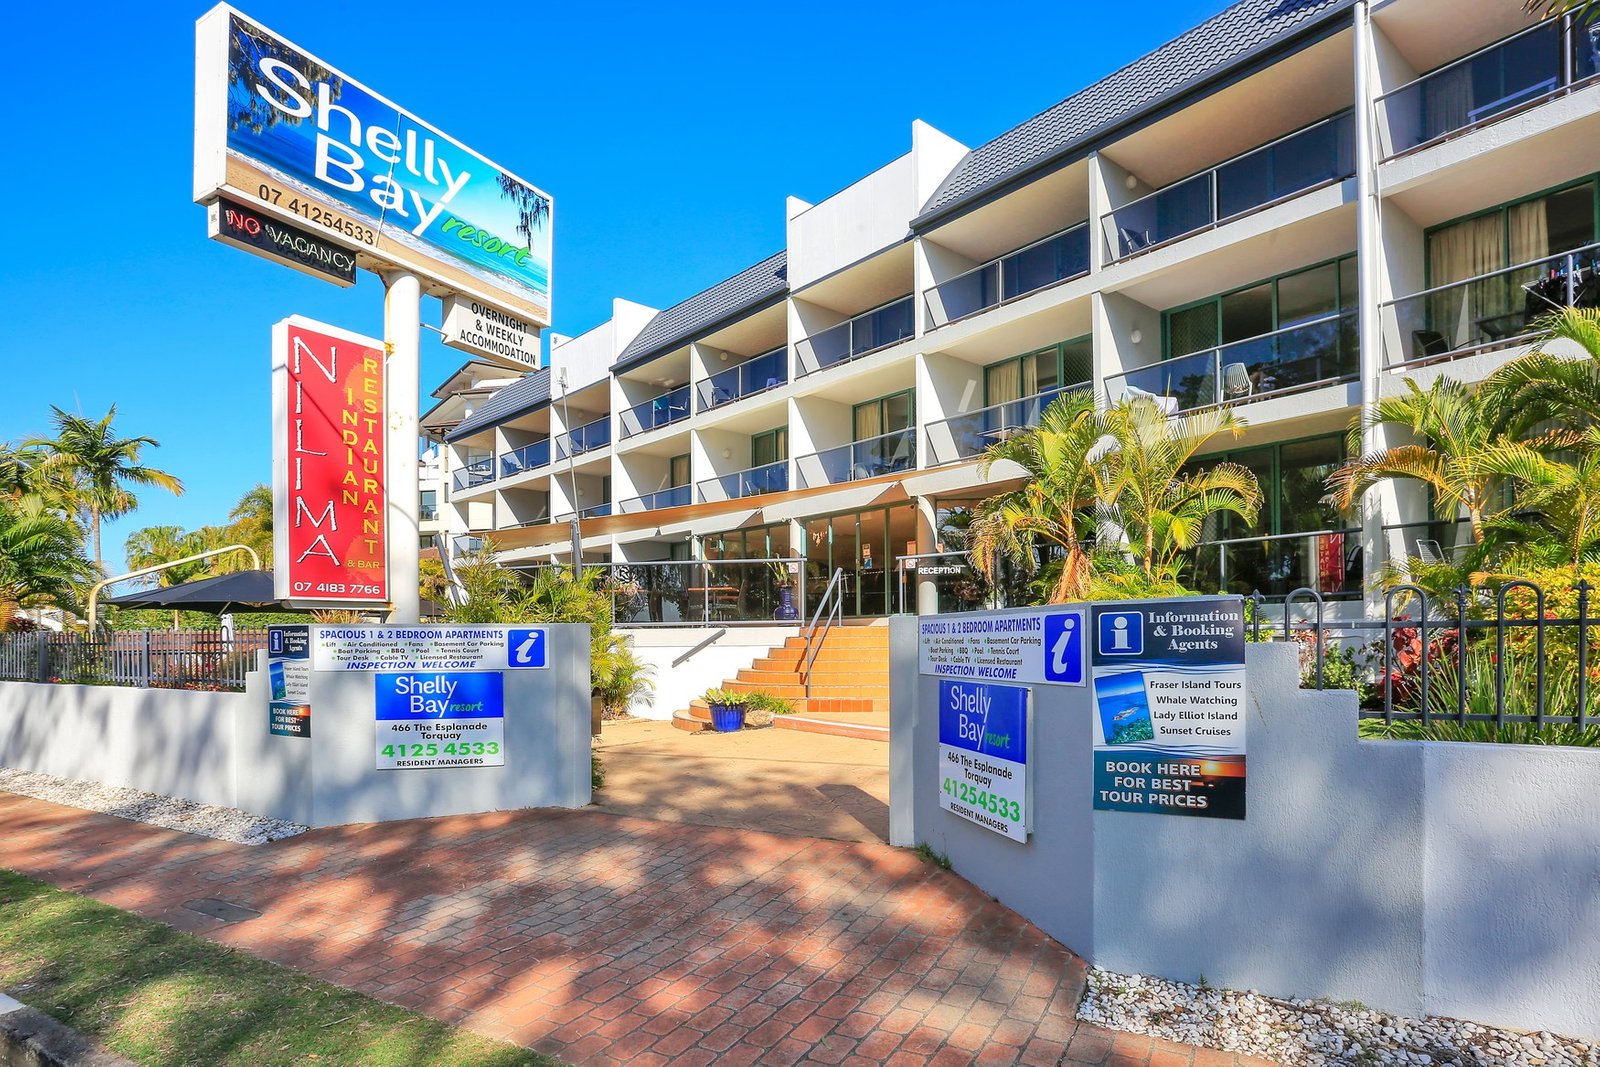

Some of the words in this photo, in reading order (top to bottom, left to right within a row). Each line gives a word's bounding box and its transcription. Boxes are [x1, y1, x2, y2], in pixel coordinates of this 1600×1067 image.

[255, 57, 471, 203] Shelly
[314, 132, 446, 237] Bay
[441, 216, 533, 267] resort
[258, 184, 282, 206] 07
[288, 198, 374, 246] 41254533
[227, 210, 260, 234] NO
[270, 226, 355, 272] VACANCY
[471, 302, 528, 334] OVERNIGHT
[475, 319, 483, 332] &
[486, 323, 524, 346] WEEKLY
[460, 329, 536, 365] ACCOMMODATION
[292, 335, 341, 567] NILIMA
[342, 387, 359, 506] INDIAN
[362, 357, 380, 556] RESTAURANT
[347, 559, 355, 568] &
[357, 560, 380, 569] BAR
[918, 566, 961, 575] RECEPTION
[294, 582, 312, 591] 07
[316, 583, 346, 593] 4183
[349, 584, 381, 594] 7766
[1149, 610, 1239, 624] Information
[922, 623, 946, 634] SPACIOUS
[952, 623, 956, 634] &
[958, 622, 961, 633] 2
[963, 621, 993, 633] BEDROOM
[995, 617, 1040, 632] APARTMENTS
[1153, 625, 1168, 637] &
[1171, 624, 1234, 638] Booking
[320, 630, 366, 639] SPACIOUS
[378, 630, 384, 639] &
[388, 630, 393, 639] 2
[396, 630, 442, 639] BEDROOM
[445, 630, 503, 639] APARTMENTS
[1020, 637, 1041, 646] Parking
[939, 647, 953, 655] Parking
[1006, 647, 1020, 655] Court
[1168, 639, 1218, 653] Agents
[997, 657, 1022, 665] Restaurant
[935, 664, 975, 676] INSPECTION
[979, 667, 1017, 679] WELCOME
[395, 675, 458, 699] Shelly
[1150, 680, 1179, 689] Fraser
[1182, 680, 1211, 689] Island
[1214, 681, 1242, 689] Tours
[410, 695, 450, 718] Bay
[450, 701, 484, 712] resort
[950, 685, 992, 723] Shelly
[1156, 696, 1187, 704] Whale
[1190, 696, 1238, 706] Watching
[1154, 711, 1176, 722] Lady
[1179, 711, 1204, 720] Elliot
[1208, 711, 1238, 720] Island
[392, 724, 411, 732] 466
[436, 722, 488, 732] Esplanade
[959, 714, 985, 750] Bay
[985, 732, 1010, 749] resort
[1160, 726, 1192, 735] Sunset
[1195, 727, 1231, 736] Cruises
[421, 732, 462, 741] Torquay
[381, 744, 438, 757] 4125
[444, 742, 499, 756] 4533
[948, 752, 960, 764] 466
[960, 754, 973, 768] The
[974, 759, 1012, 780] Esplanade
[1106, 762, 1152, 774] BOOK
[1158, 763, 1202, 776] HERE
[964, 768, 992, 788] Torquay
[1114, 777, 1146, 789] FOR
[1152, 778, 1192, 791] BEST
[943, 777, 1020, 823] 41254533
[1100, 790, 1143, 803] TOUR
[1149, 793, 1208, 808] PRICES
[950, 802, 974, 819] RESIDENT
[975, 812, 1008, 833] MANAGERS
